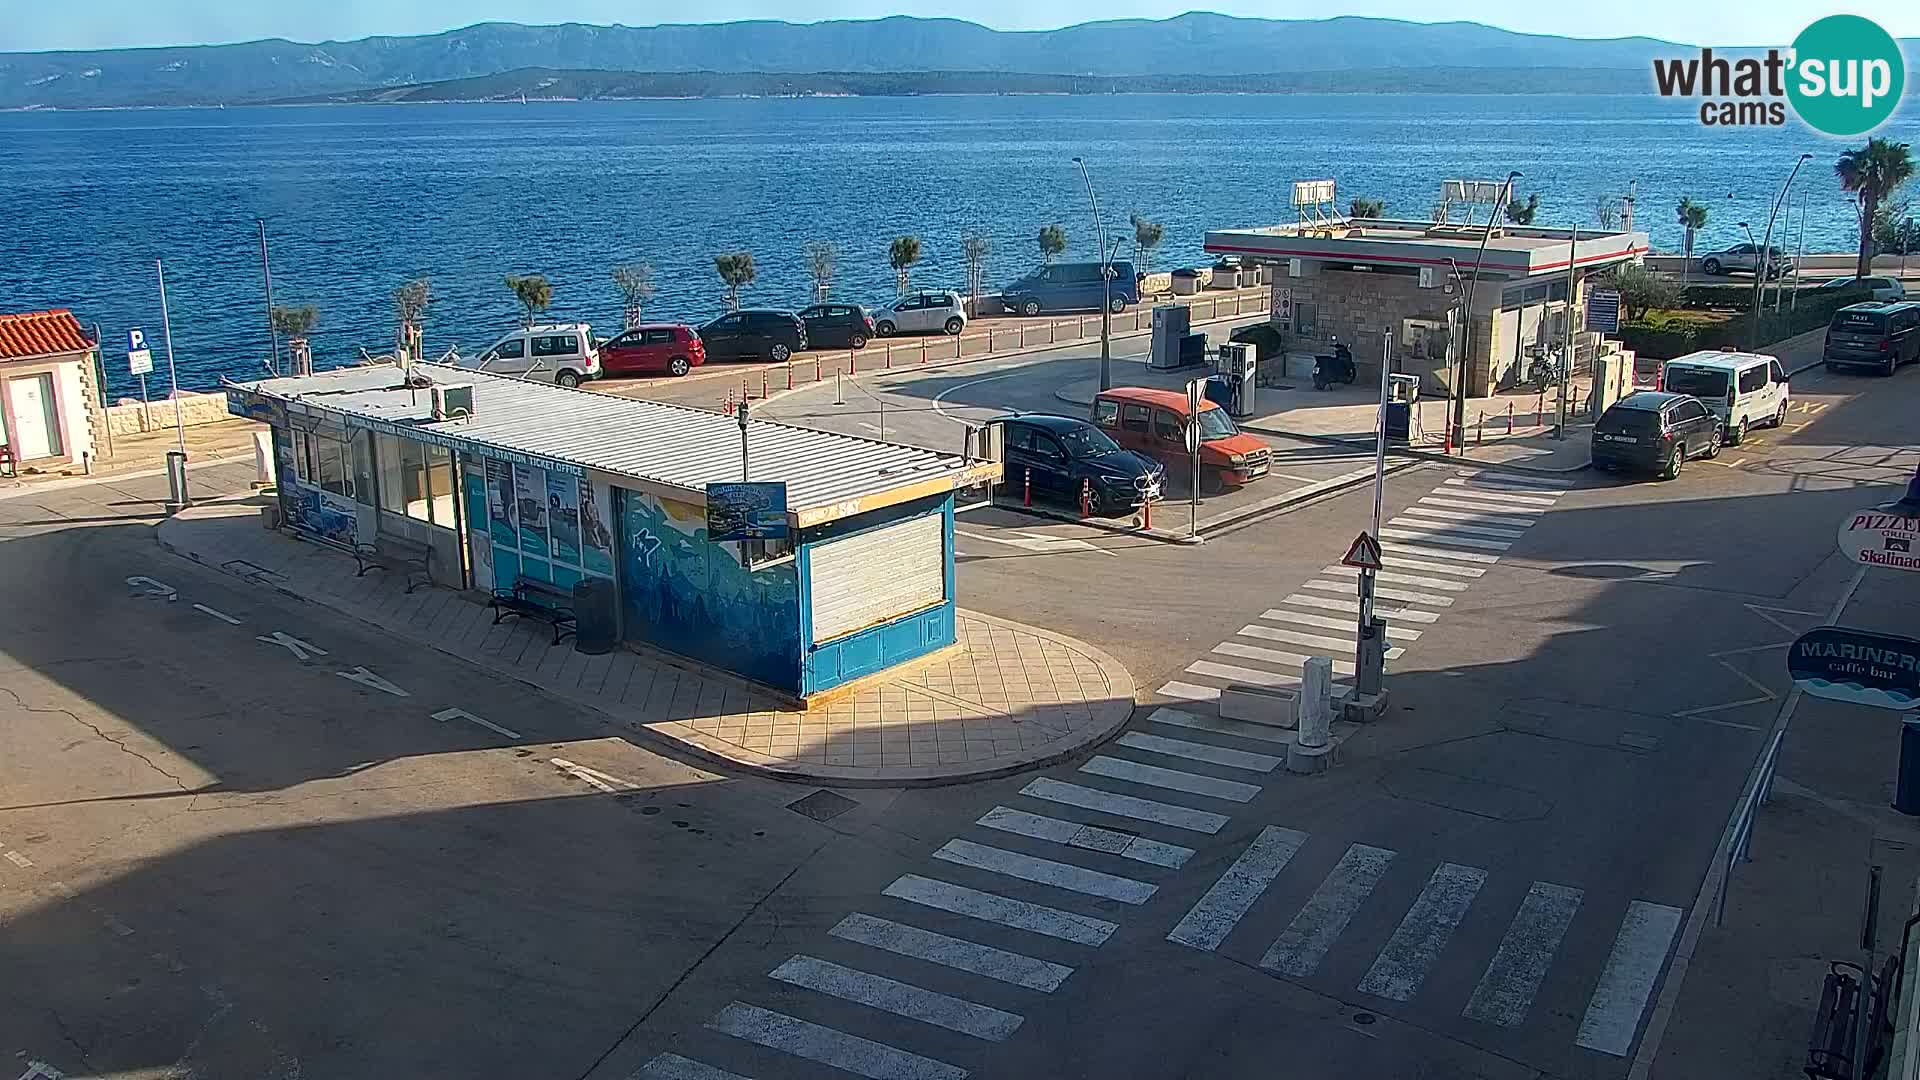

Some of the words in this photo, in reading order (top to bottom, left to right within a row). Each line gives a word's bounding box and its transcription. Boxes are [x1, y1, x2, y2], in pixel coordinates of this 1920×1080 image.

[479, 445, 493, 457] BUS
[495, 449, 527, 463] STATION
[529, 456, 555, 470] TICKET
[555, 461, 583, 476] OFFICE
[1848, 515, 1920, 532] PIZZE
[1870, 665, 1897, 680] bar
